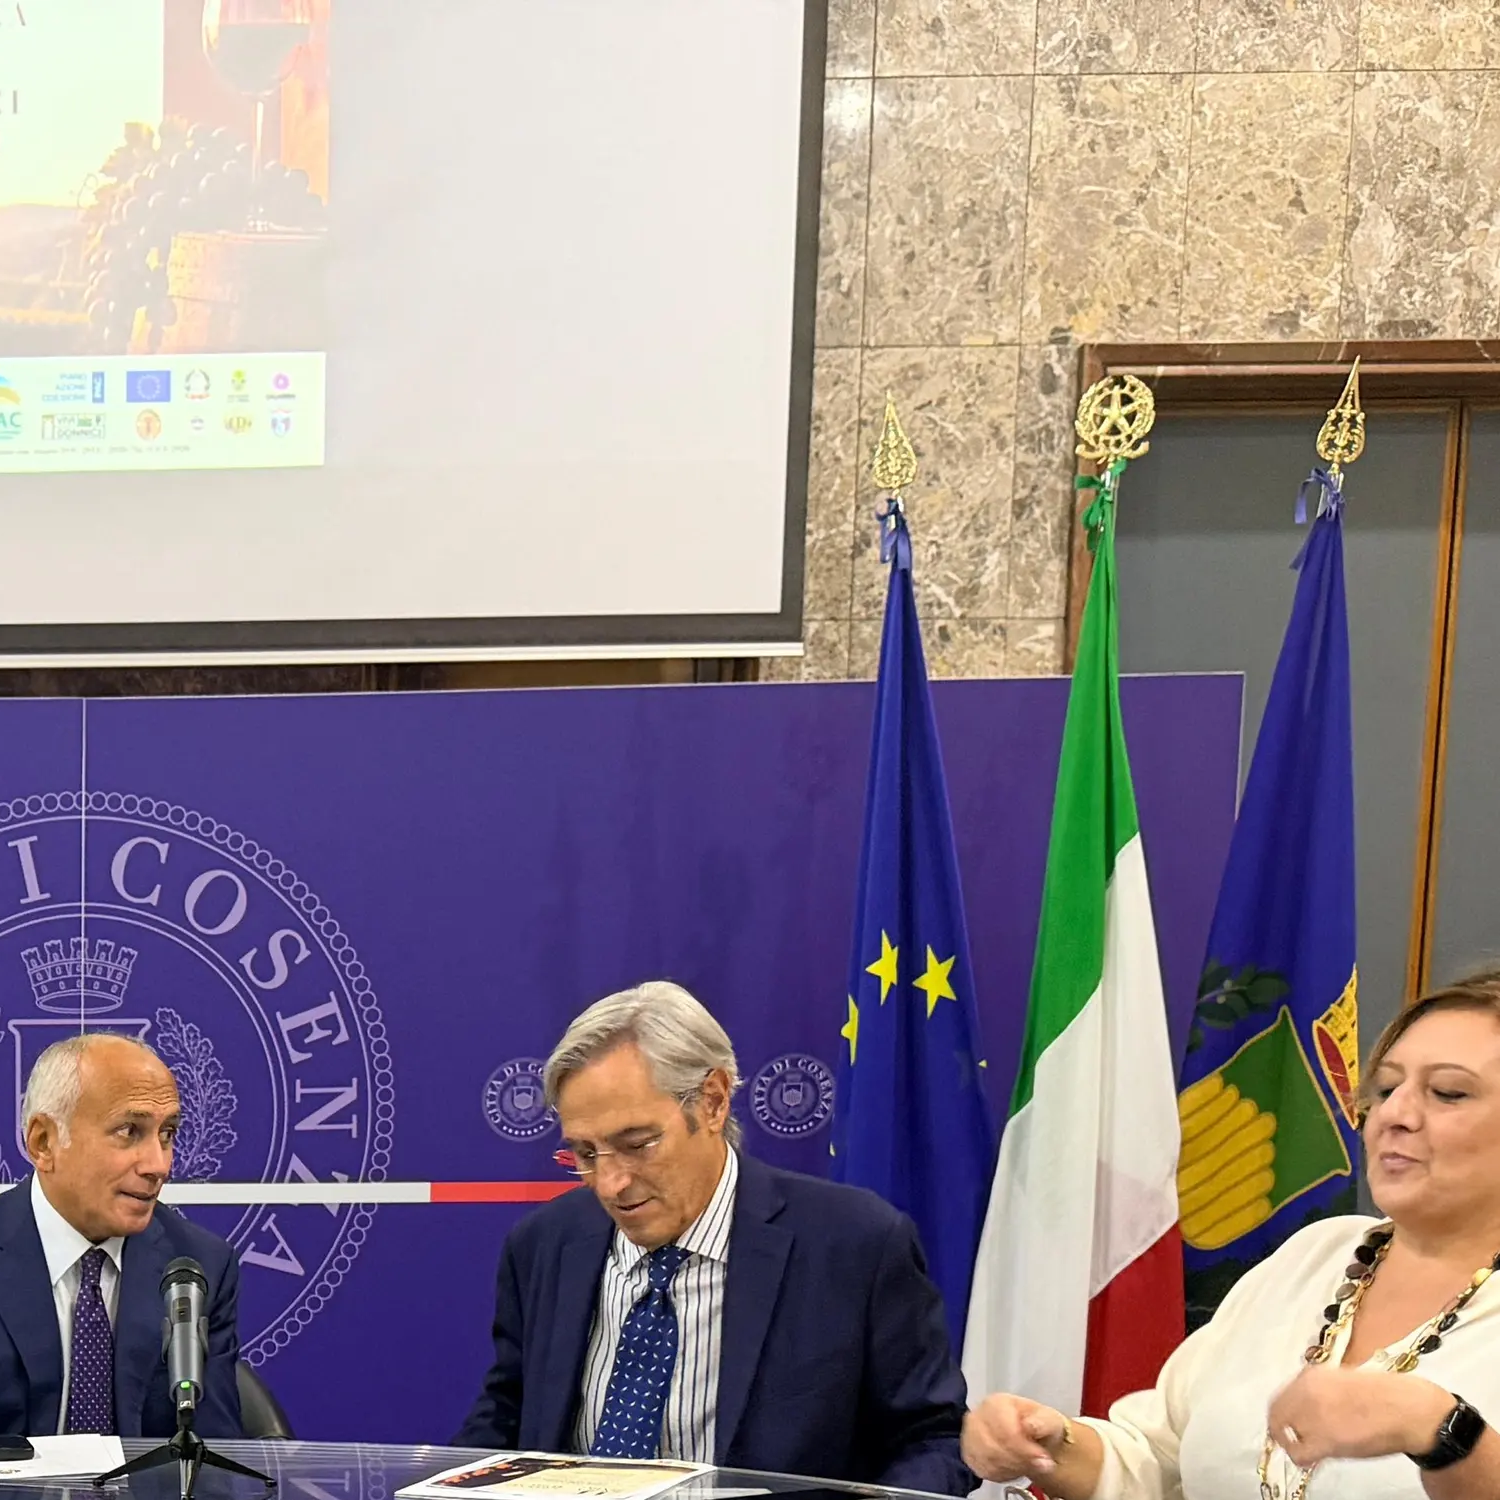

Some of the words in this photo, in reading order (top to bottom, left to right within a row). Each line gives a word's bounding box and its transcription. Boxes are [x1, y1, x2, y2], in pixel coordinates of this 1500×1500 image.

[111, 836, 358, 1275] COSENZA
[503, 1063, 520, 1077] DI
[772, 1059, 790, 1073] DI
